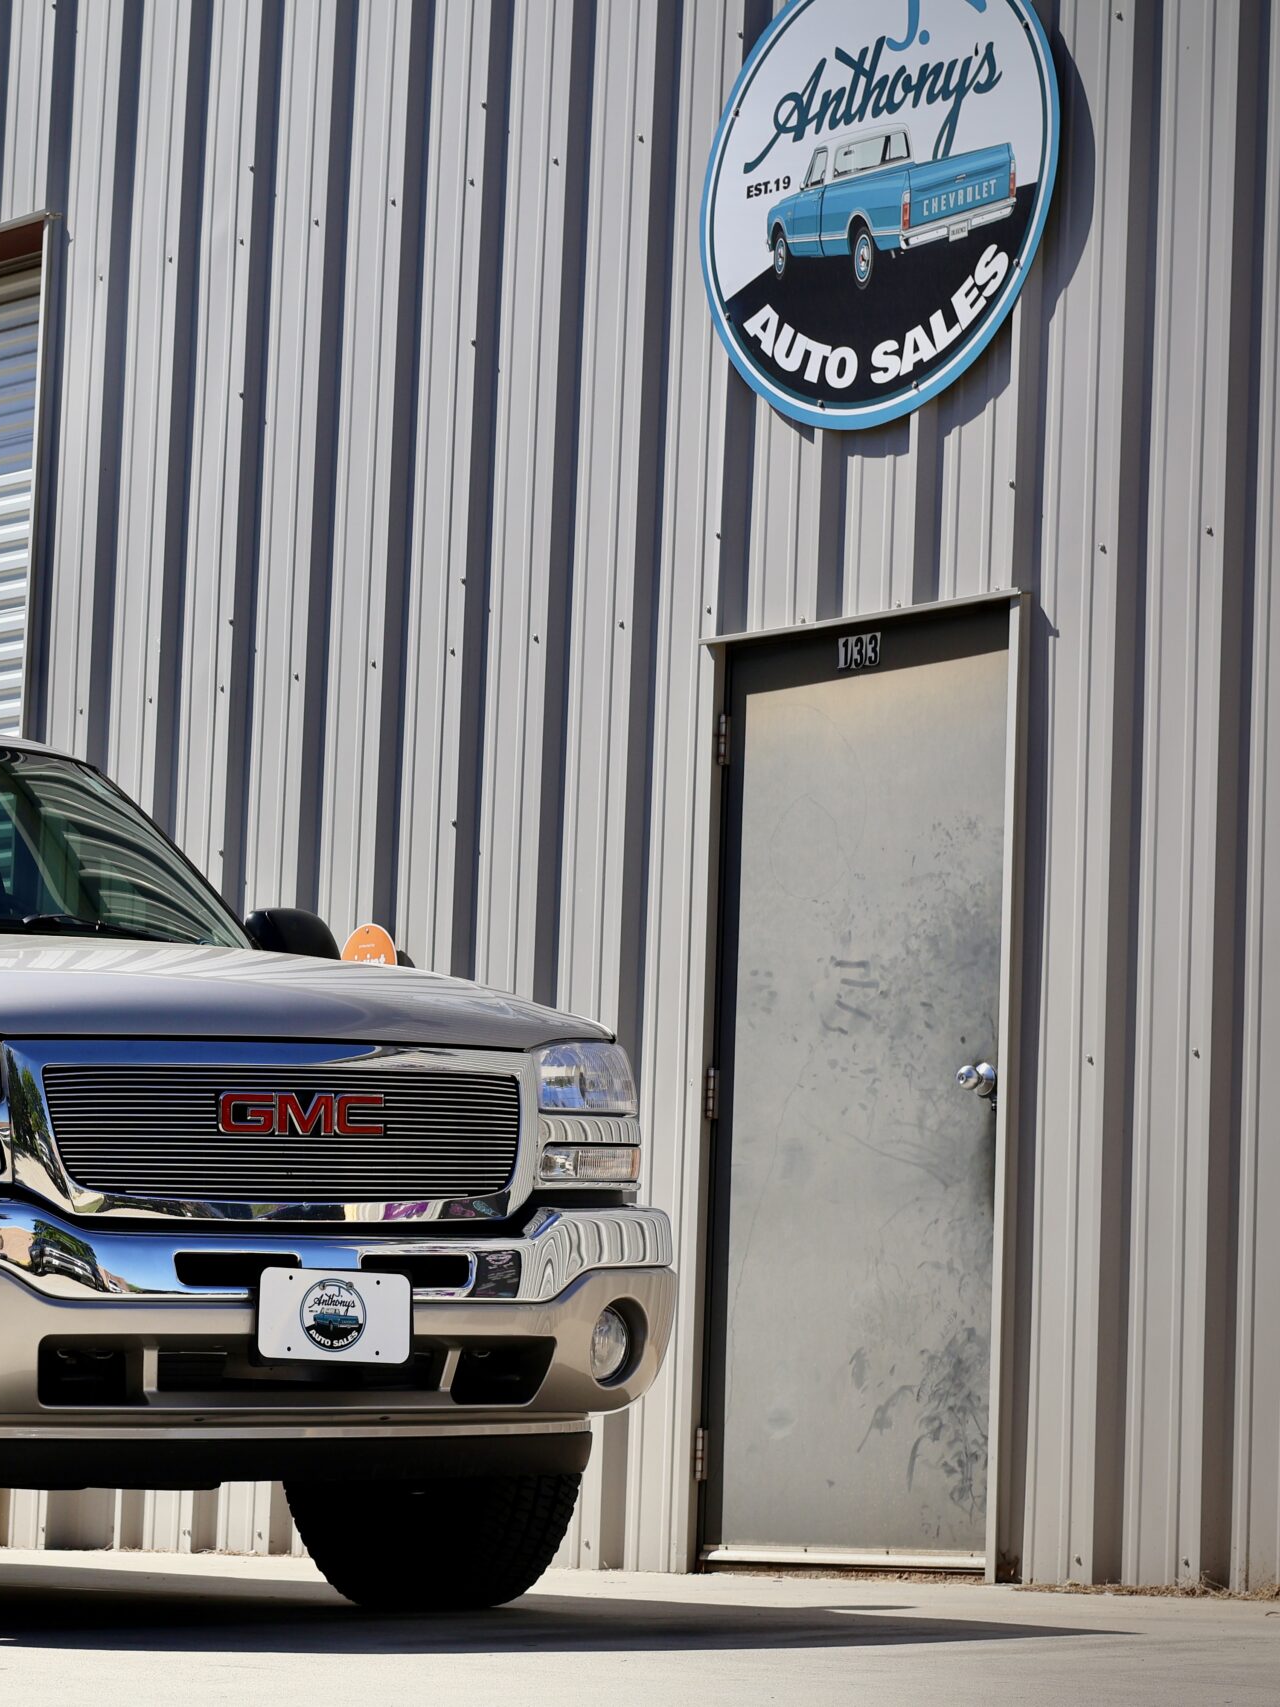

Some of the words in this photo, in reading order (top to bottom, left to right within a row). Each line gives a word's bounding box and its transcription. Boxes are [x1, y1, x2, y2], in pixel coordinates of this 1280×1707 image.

[743, 36, 1002, 174] Anthony's
[923, 180, 996, 216] CHEVROLET
[743, 304, 858, 389] AUTO
[870, 244, 1009, 384] SALES
[840, 632, 880, 669] 133
[218, 1091, 384, 1136] GMC
[309, 1329, 331, 1346] AUTO
[332, 1330, 358, 1347] SALES
